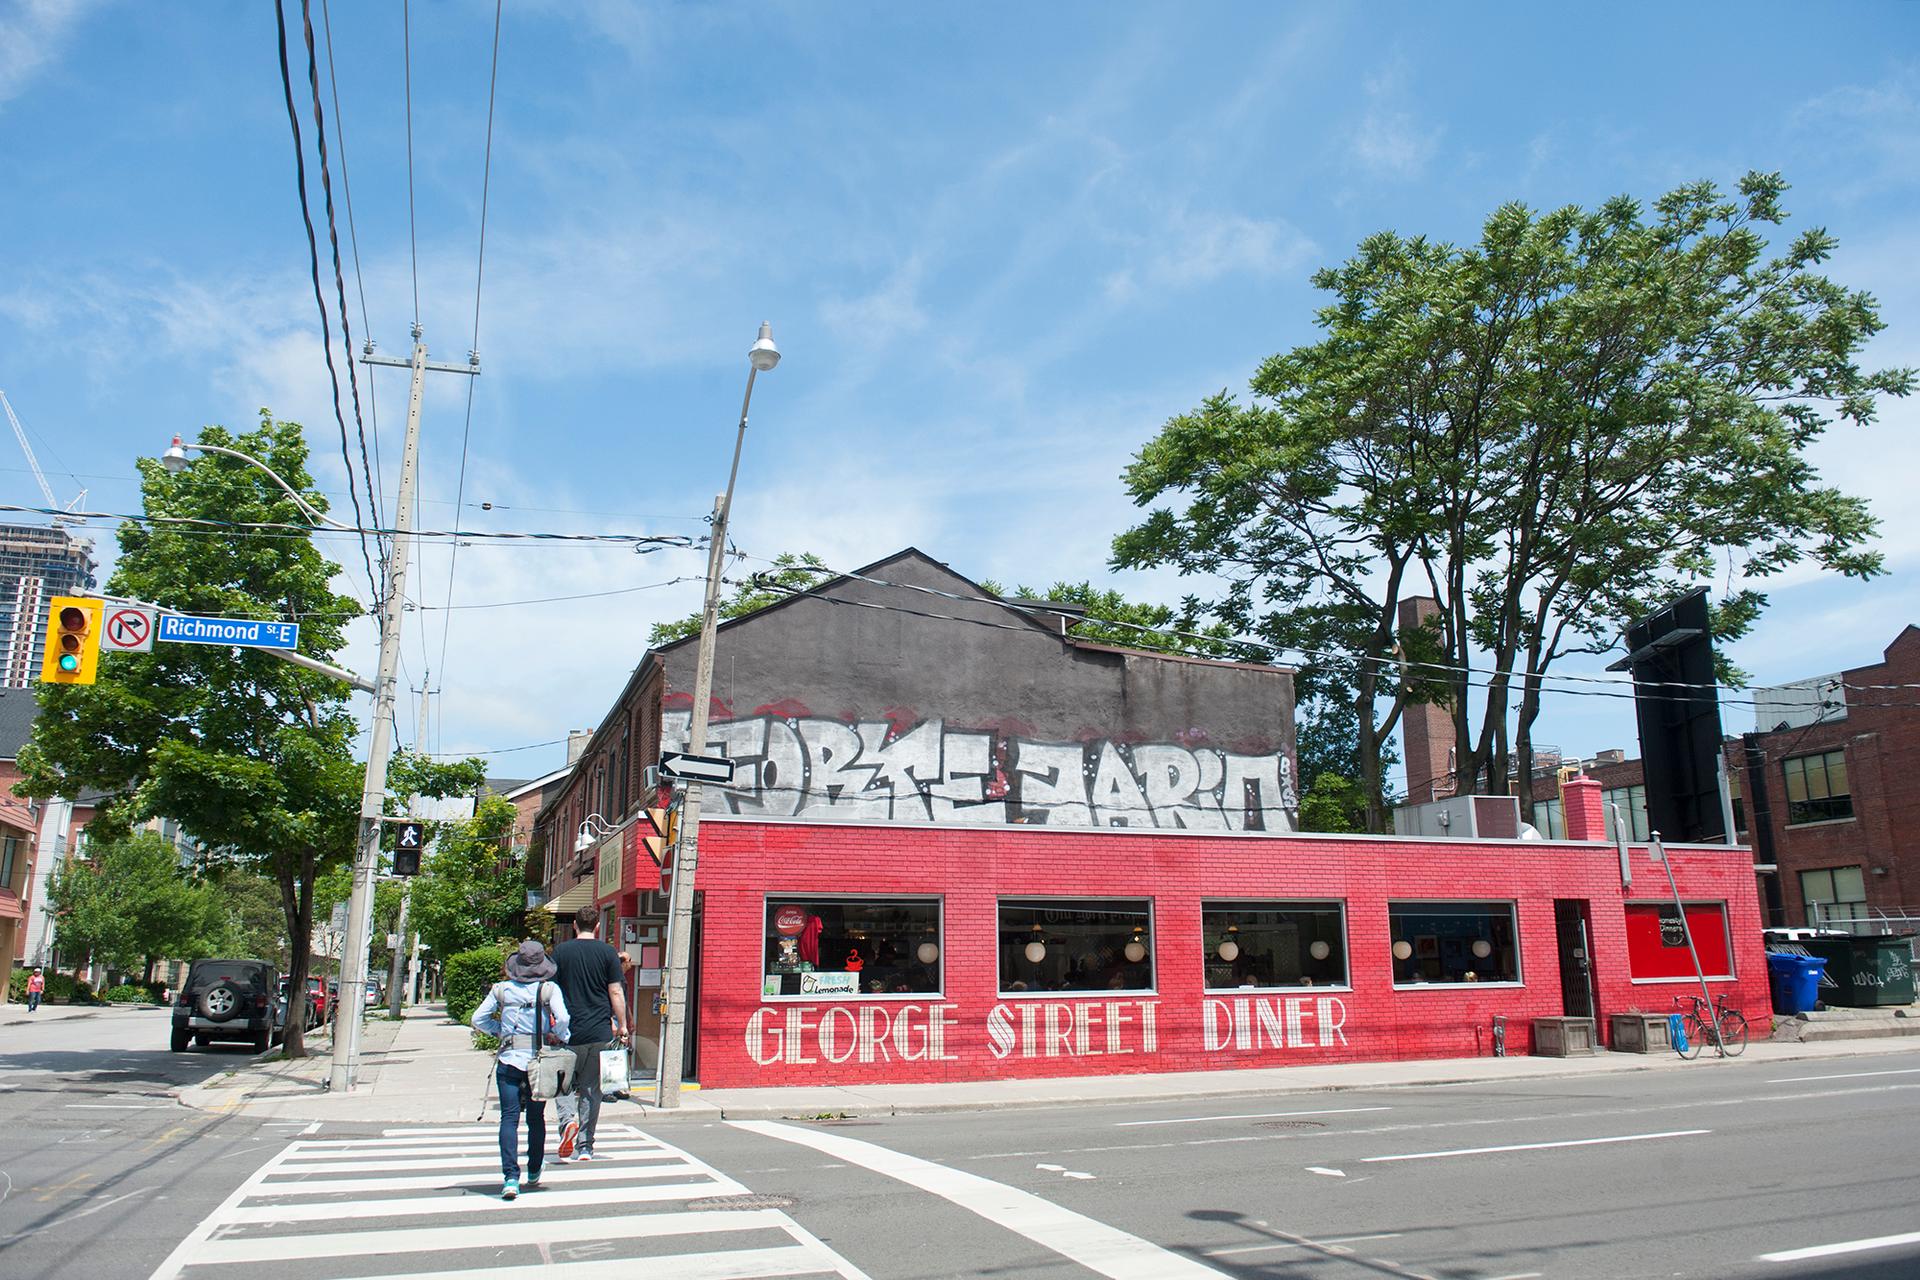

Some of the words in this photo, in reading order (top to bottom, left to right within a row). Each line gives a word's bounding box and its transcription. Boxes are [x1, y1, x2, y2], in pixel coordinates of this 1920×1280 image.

[166, 617, 259, 640] Richmond
[280, 626, 292, 642] E
[820, 974, 851, 985] FRESH
[814, 984, 854, 994] Lemonade
[744, 1003, 959, 1065] GEORGE
[985, 1000, 1162, 1060] STREET
[1202, 996, 1349, 1051] DINER
